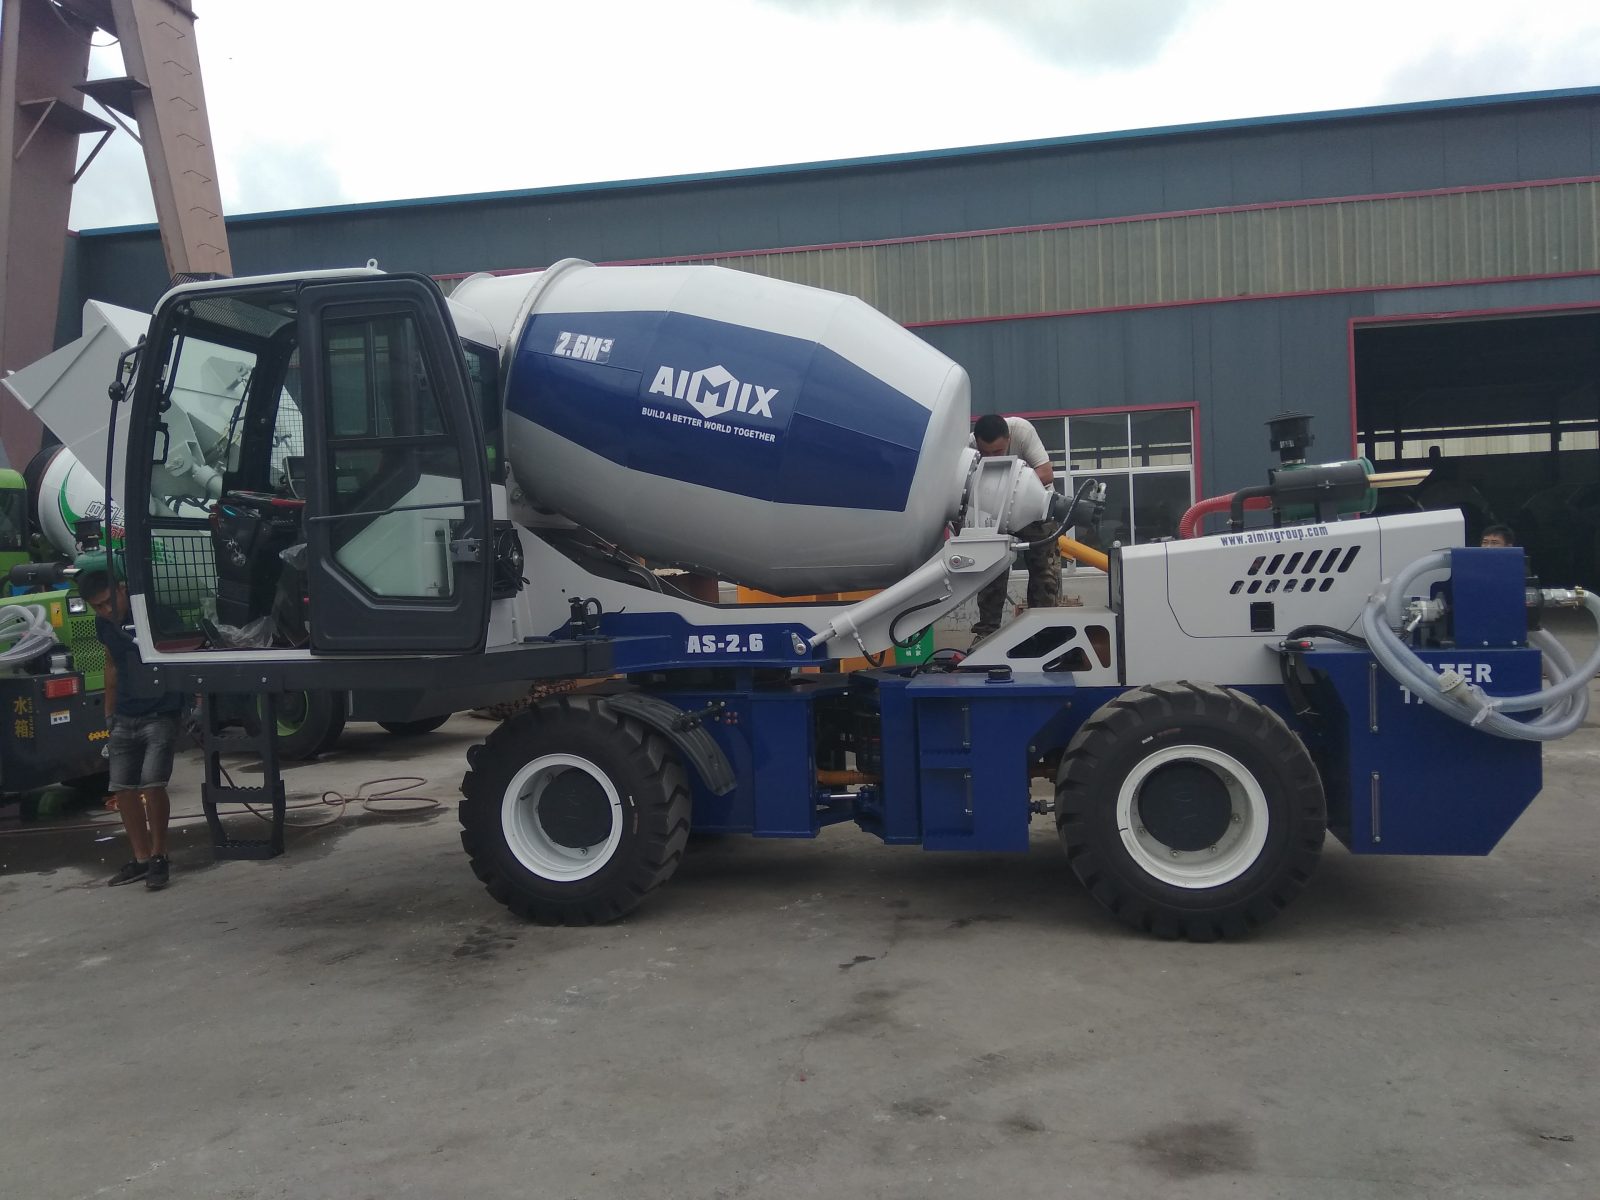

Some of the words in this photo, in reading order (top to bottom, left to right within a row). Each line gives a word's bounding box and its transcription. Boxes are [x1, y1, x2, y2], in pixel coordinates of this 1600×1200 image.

[648, 364, 780, 418] AIMIX
[641, 407, 665, 419] BUILD
[665, 412, 672, 421] A
[672, 413, 702, 428] BETTER
[704, 420, 732, 433] WORLD
[733, 426, 776, 442] TOGETHER
[1220, 526, 1328, 546] www.aimixgroup.com
[687, 633, 763, 654] AS-2.6
[1426, 663, 1493, 683] TER
